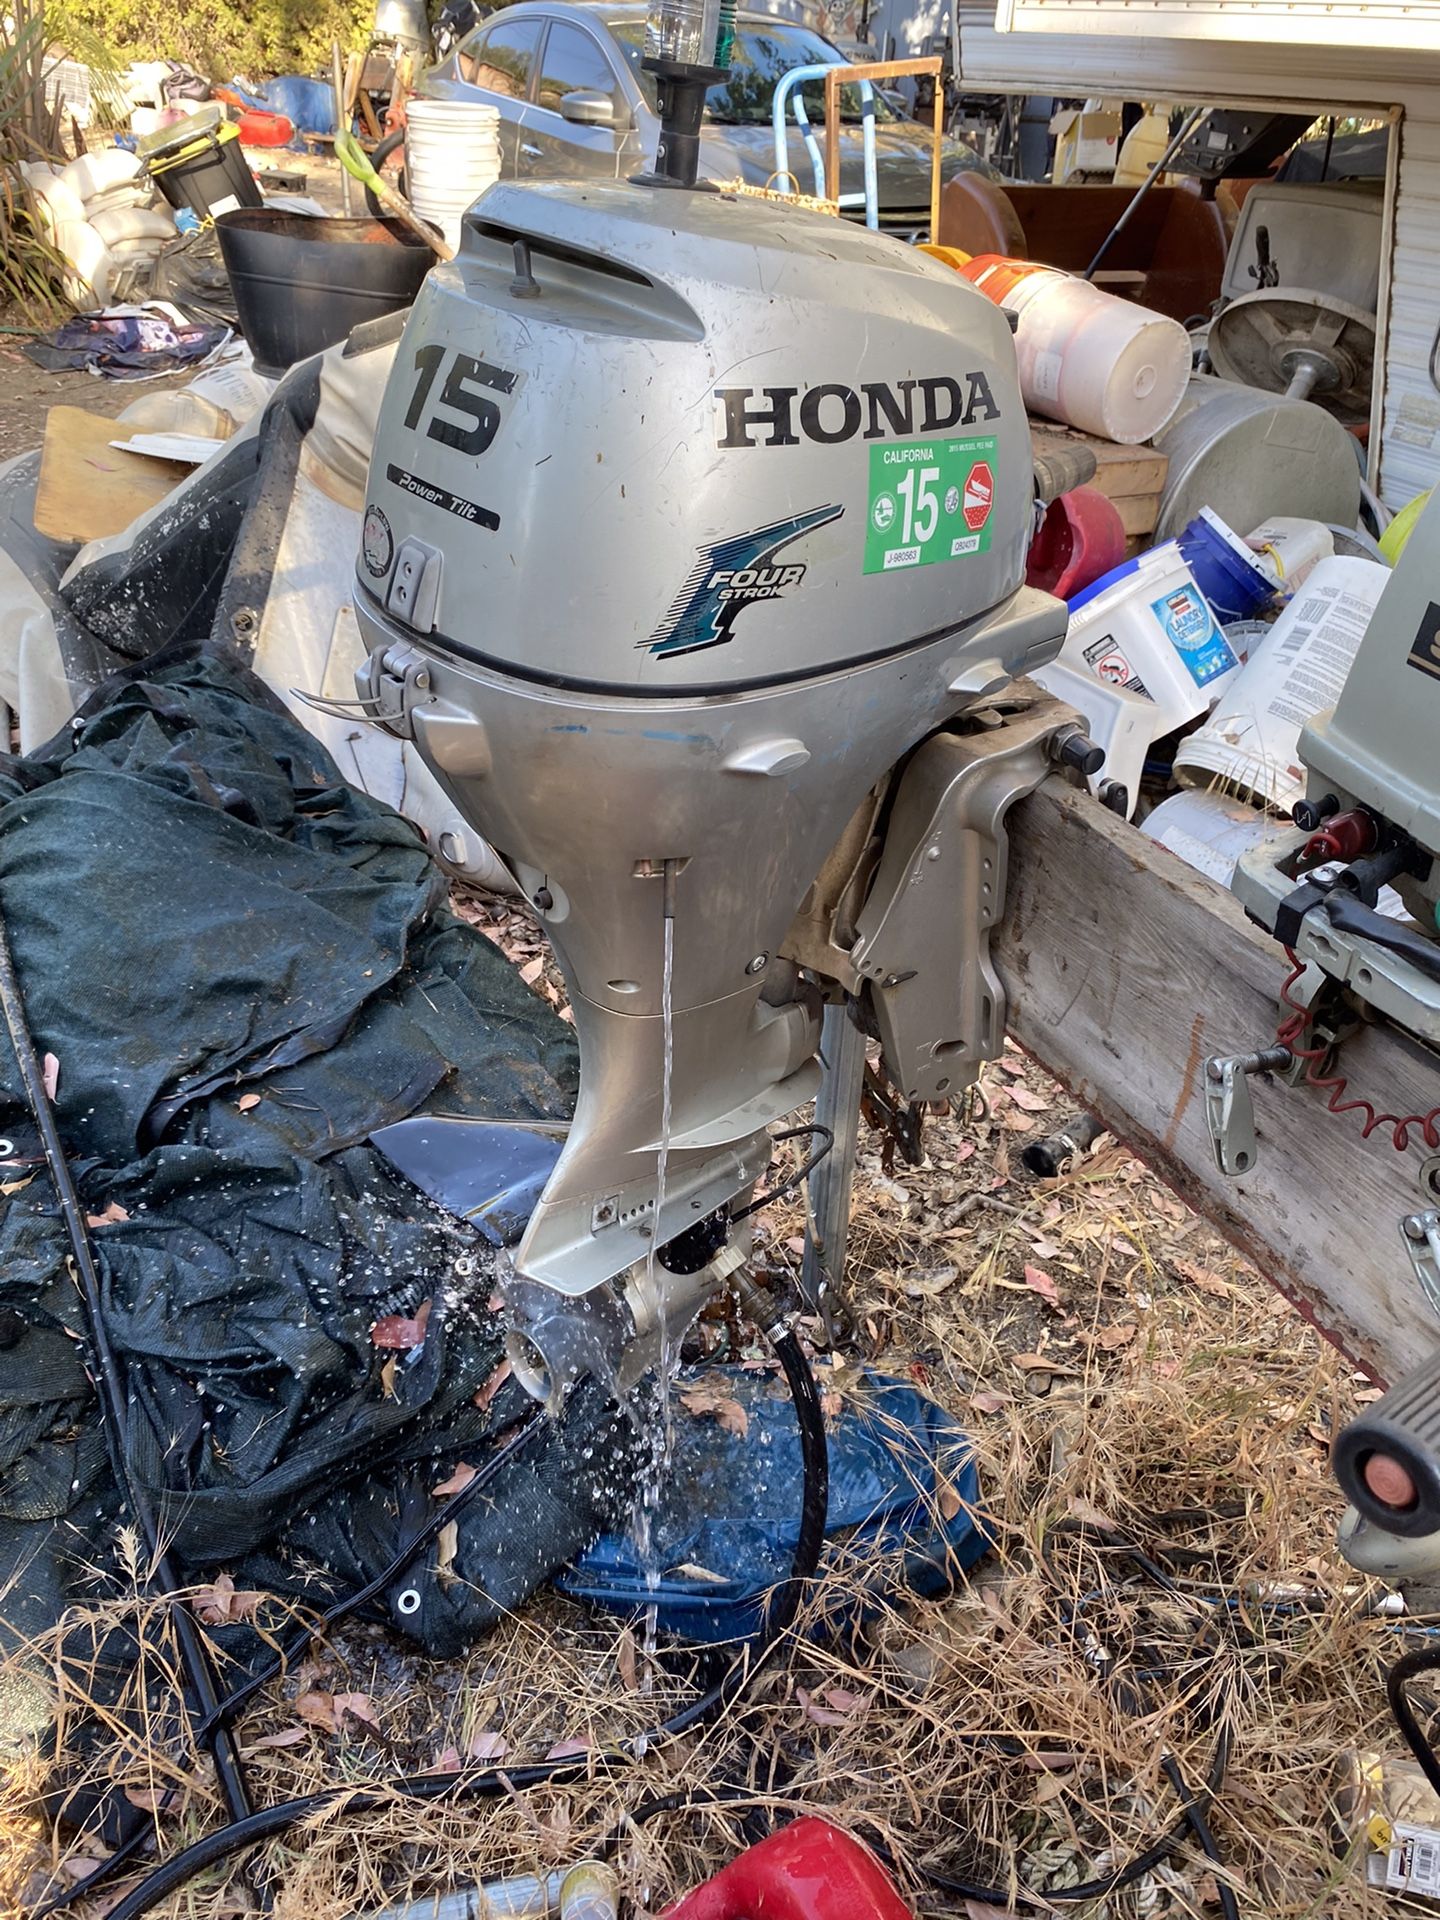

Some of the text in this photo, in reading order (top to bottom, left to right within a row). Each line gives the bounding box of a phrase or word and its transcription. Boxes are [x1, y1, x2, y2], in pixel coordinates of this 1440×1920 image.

[404, 344, 519, 456] 15
[714, 371, 1000, 448] HONDA
[883, 448, 934, 464] CALIFORNIA
[399, 473, 477, 519] Power Tilt
[897, 467, 940, 545] 15
[707, 565, 805, 589] FOUR
[718, 586, 782, 600] STROK
